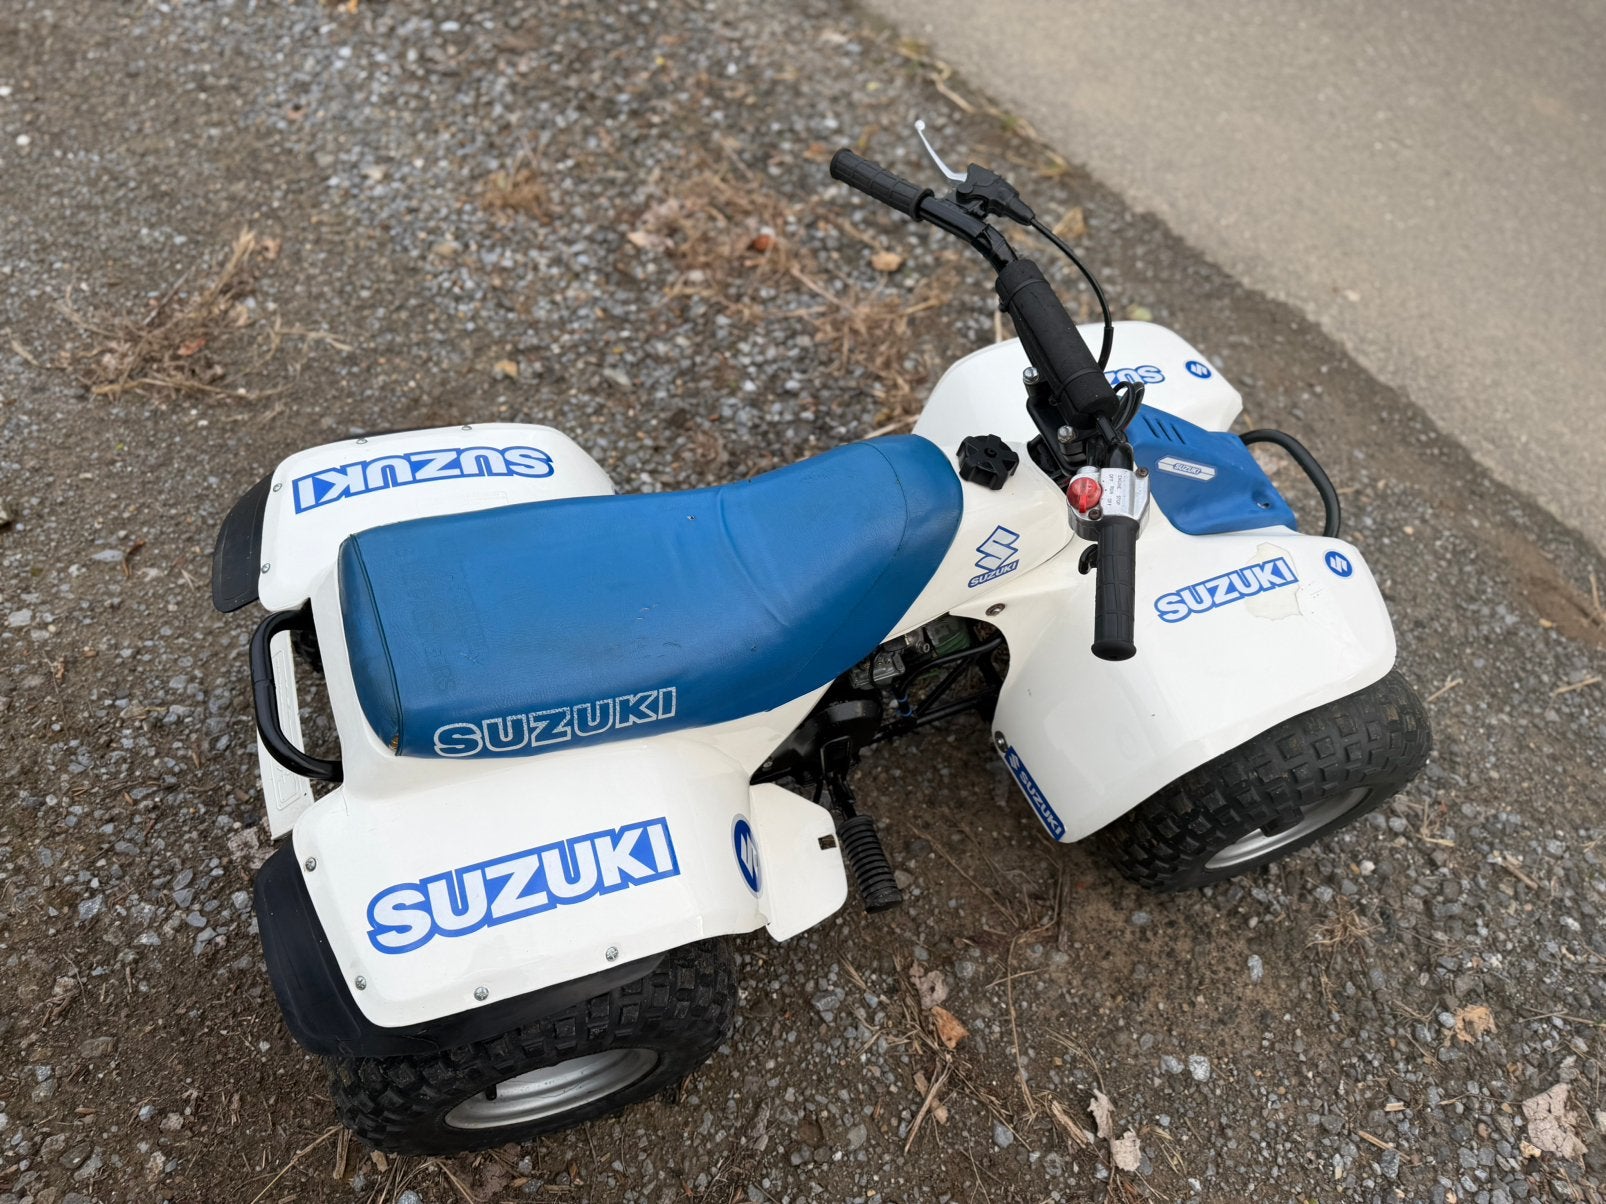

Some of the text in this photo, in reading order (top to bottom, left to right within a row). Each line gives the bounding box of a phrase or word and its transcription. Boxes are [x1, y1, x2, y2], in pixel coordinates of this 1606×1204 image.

[292, 446, 554, 514] SUZUKI
[1173, 463, 1201, 475] SUZUKI
[968, 559, 1020, 588] SUZUKI
[1155, 557, 1299, 623] SUZUKI
[433, 686, 677, 757] SUZUKI
[1019, 770, 1062, 835] SUZUKI
[367, 817, 681, 955] SUZUKI
